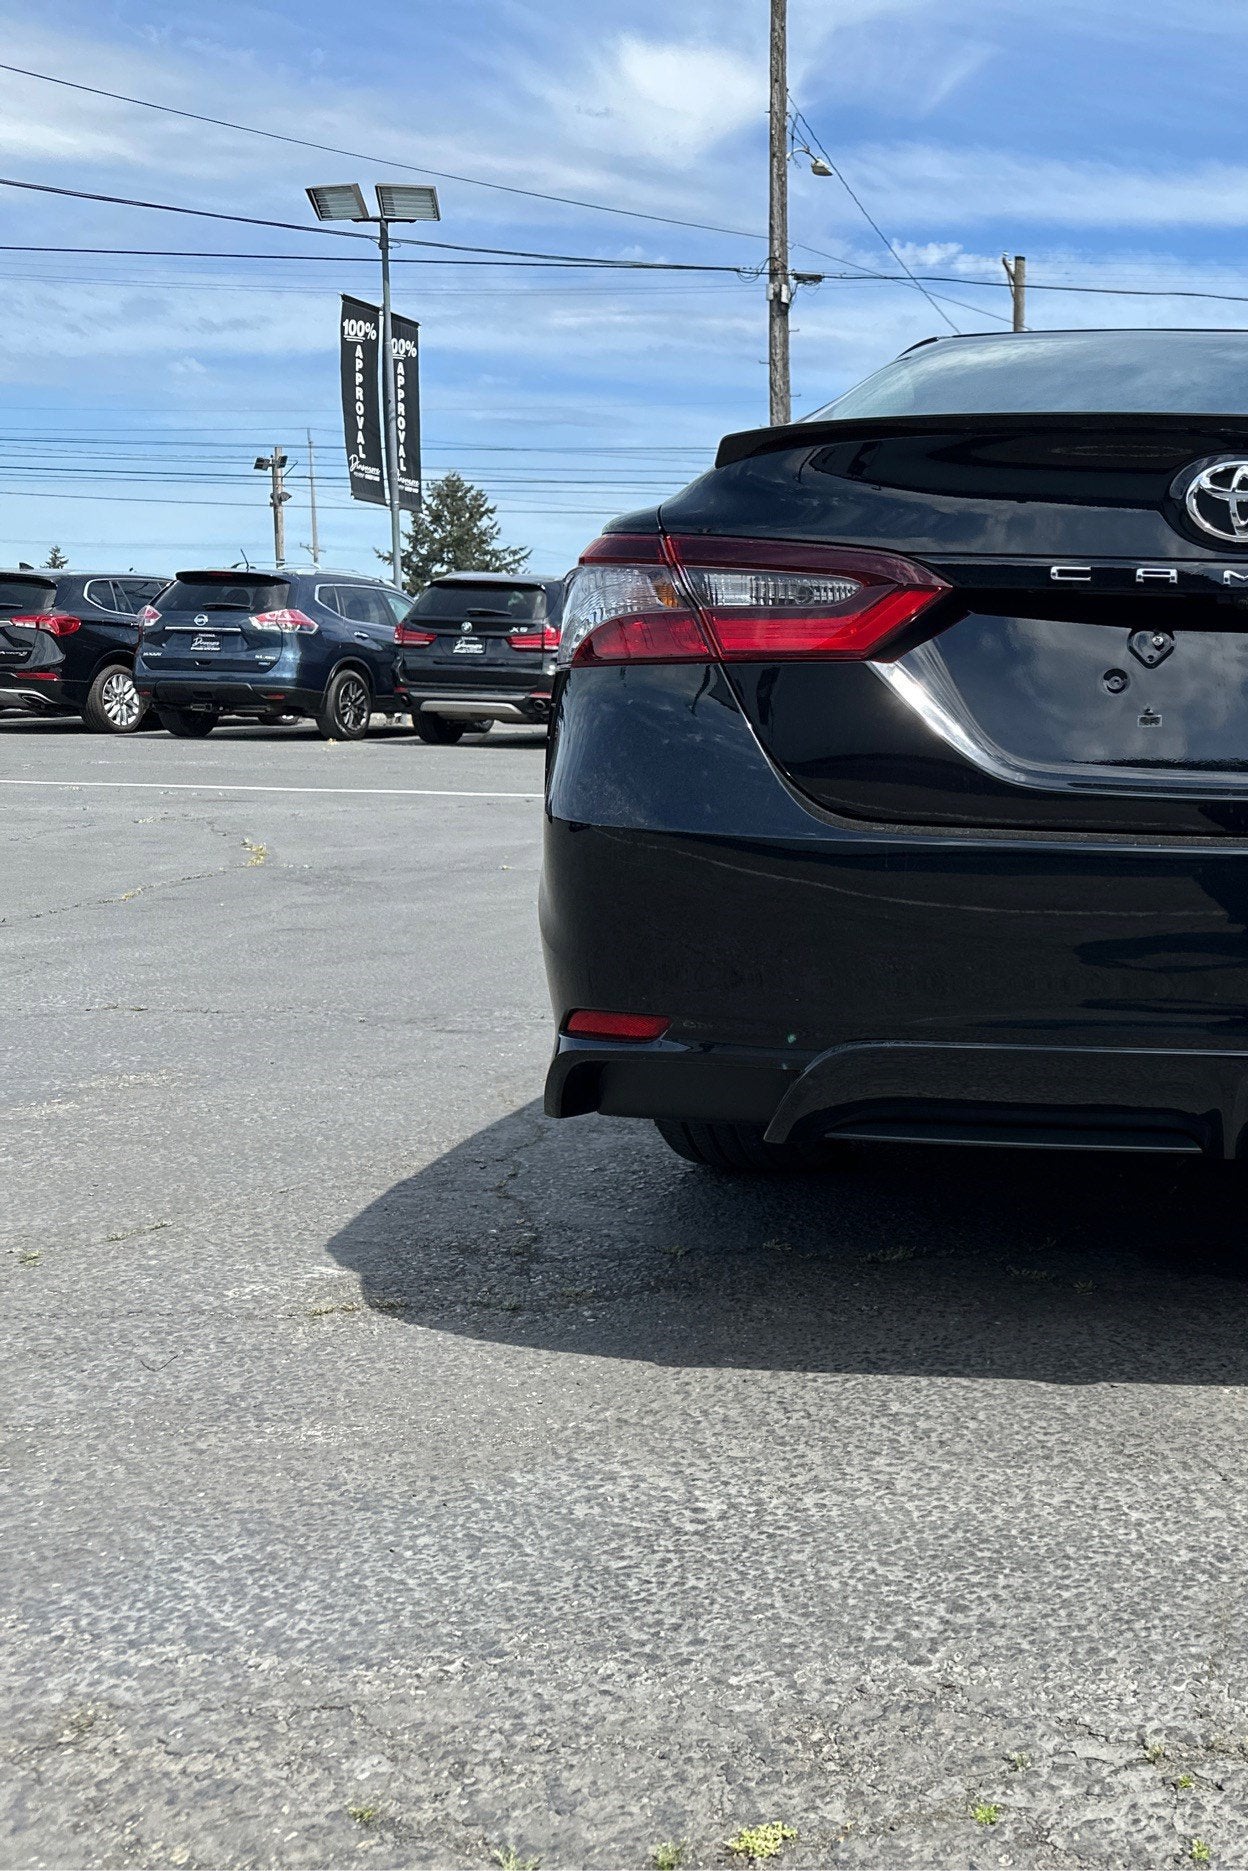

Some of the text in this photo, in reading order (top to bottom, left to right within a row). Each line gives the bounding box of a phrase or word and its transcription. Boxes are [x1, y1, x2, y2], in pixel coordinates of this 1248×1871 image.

[342, 318, 377, 341] 100%
[391, 338, 417, 358] 00%
[355, 344, 366, 459] APPROVAL
[397, 361, 407, 472] APPROVAL
